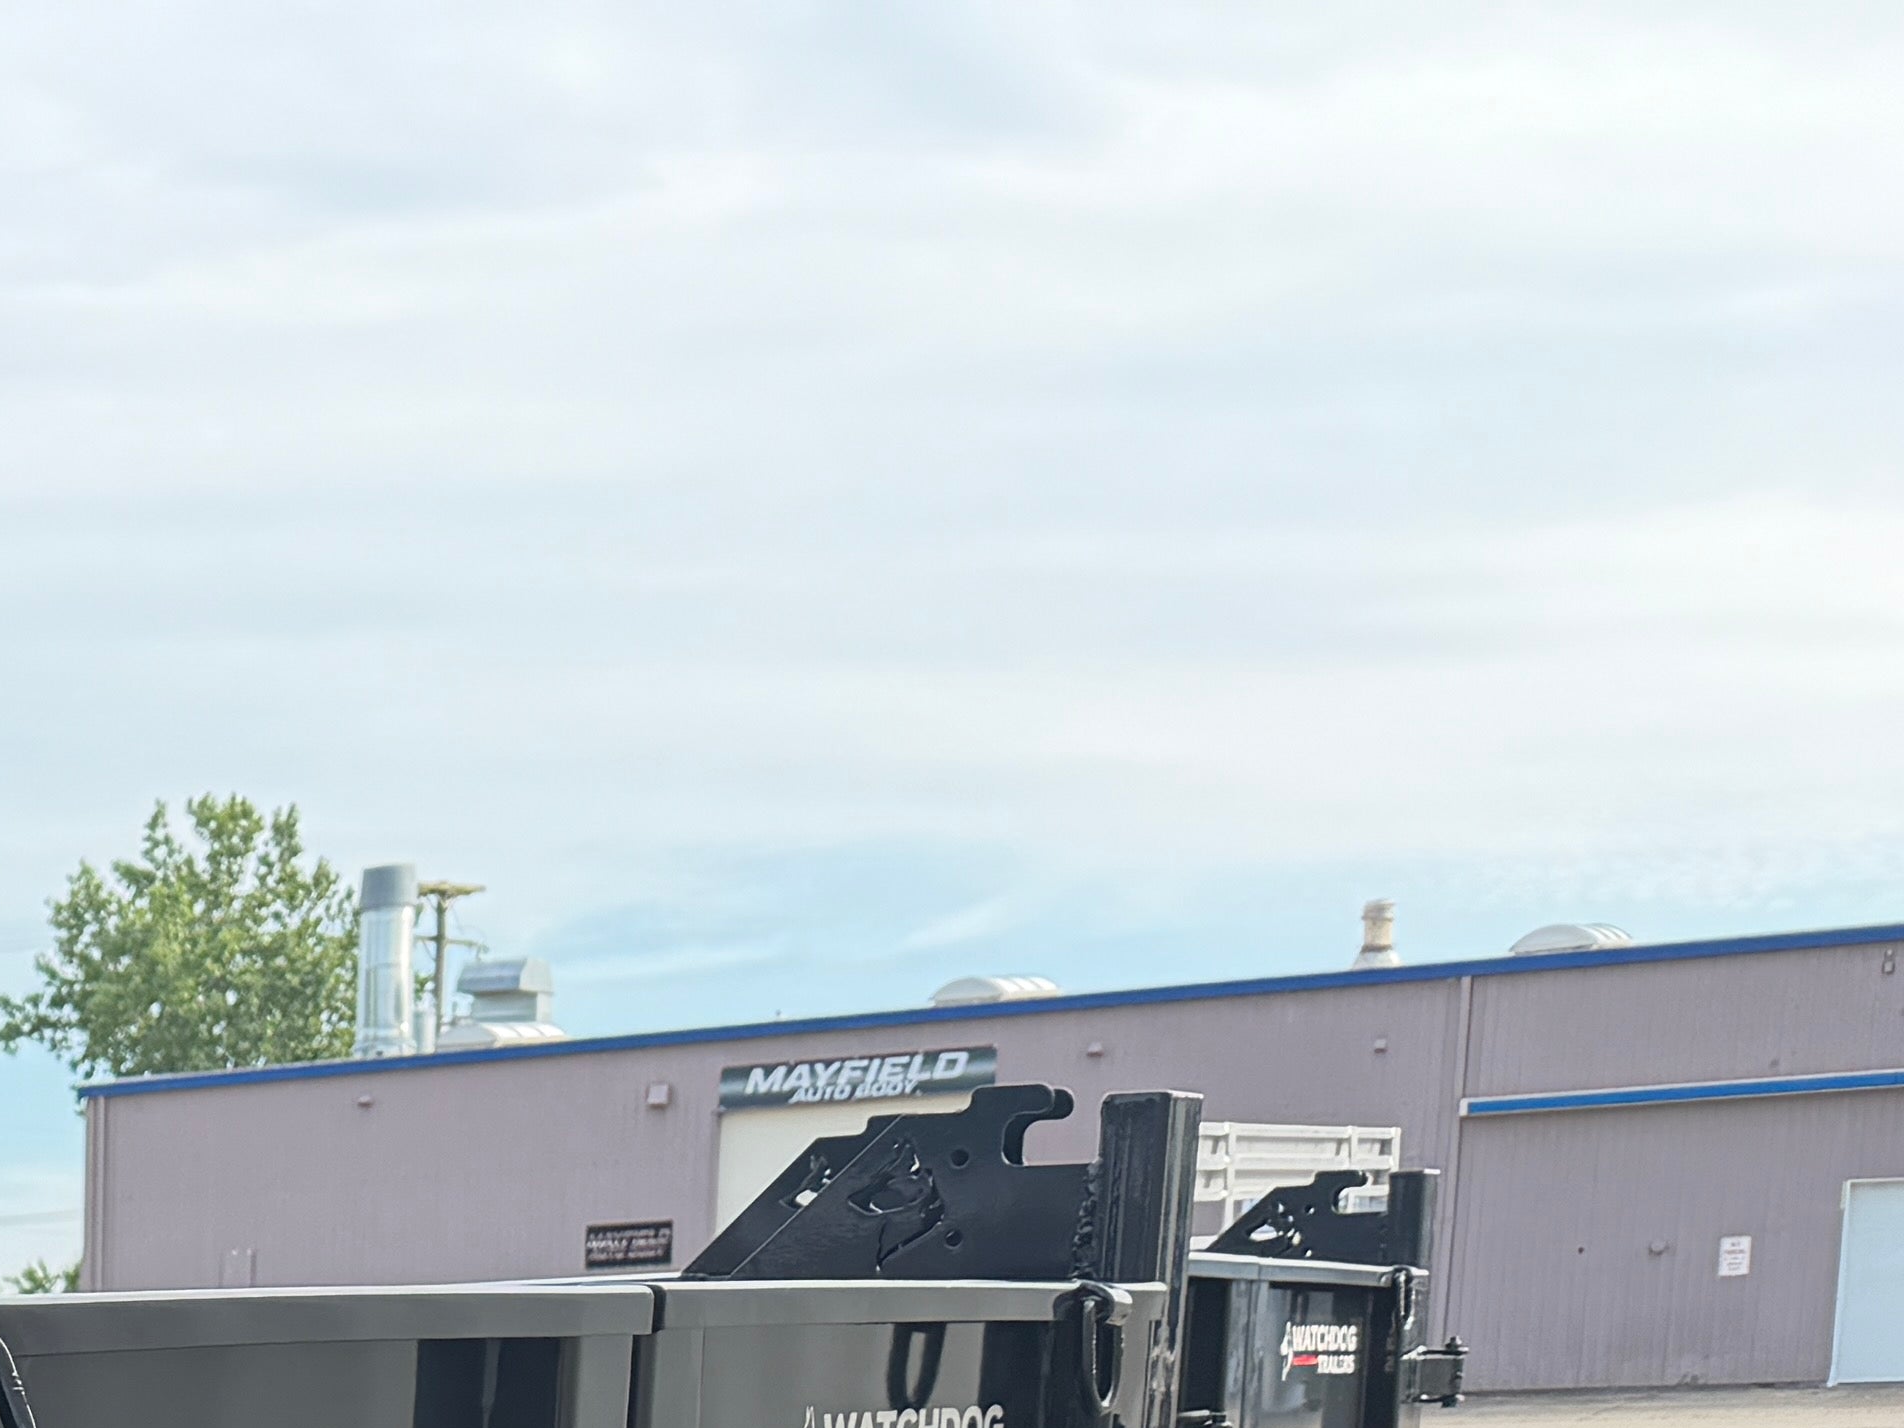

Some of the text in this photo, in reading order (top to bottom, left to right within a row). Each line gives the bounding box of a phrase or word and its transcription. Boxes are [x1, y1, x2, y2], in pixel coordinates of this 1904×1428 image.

[745, 1050, 970, 1095] MAYFIELD
[788, 1083, 852, 1104] AUTO
[1292, 1325, 1357, 1352] WATCHDOG
